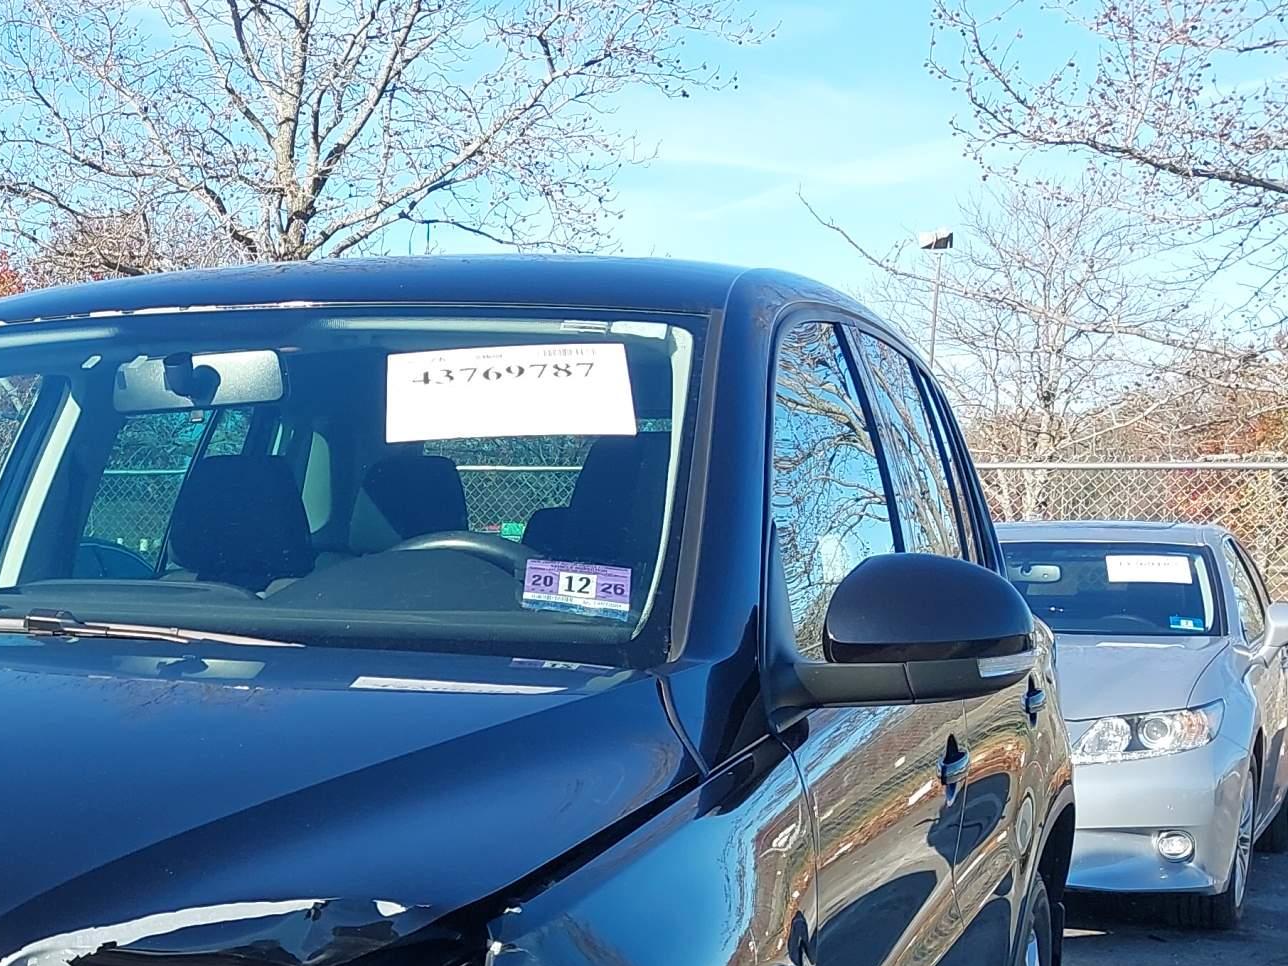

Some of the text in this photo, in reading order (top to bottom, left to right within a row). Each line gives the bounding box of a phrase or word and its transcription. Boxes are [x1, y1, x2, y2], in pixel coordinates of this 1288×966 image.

[412, 362, 595, 385] 43769787
[532, 575, 625, 596] 20 12 26
